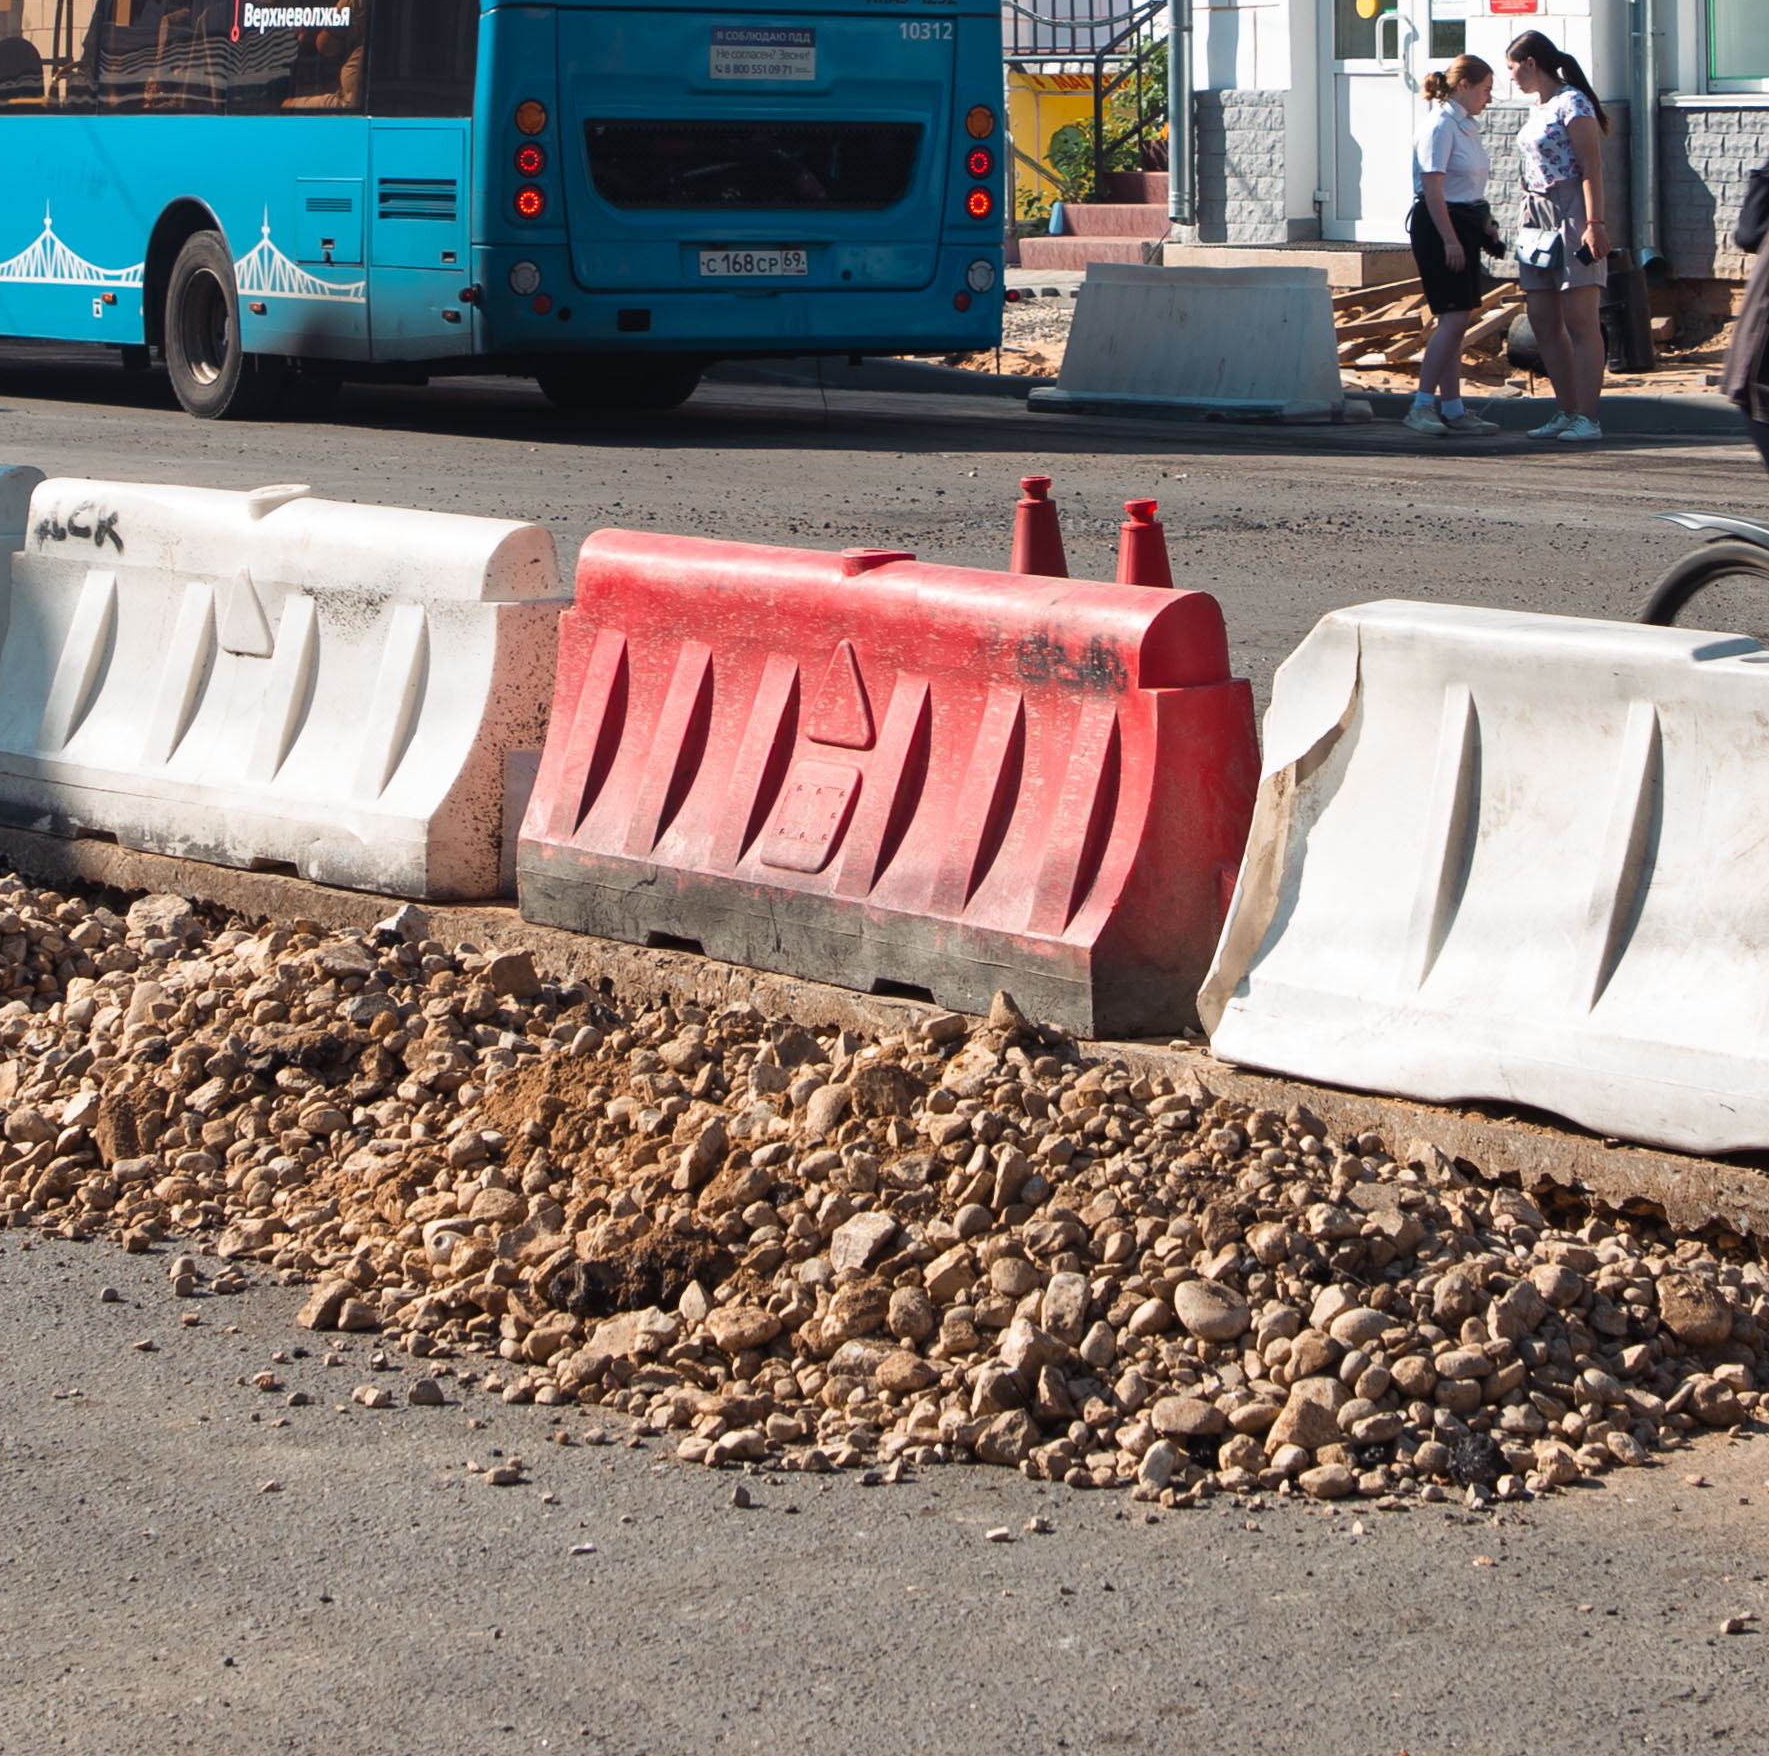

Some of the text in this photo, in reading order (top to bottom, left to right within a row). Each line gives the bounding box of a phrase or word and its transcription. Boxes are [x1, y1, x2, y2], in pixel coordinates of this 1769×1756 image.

[244, 3, 350, 34] Верхневолжья
[726, 31, 786, 43] СОБЛЮДАЮ
[788, 32, 811, 44] ПДД
[899, 22, 953, 40] 10312
